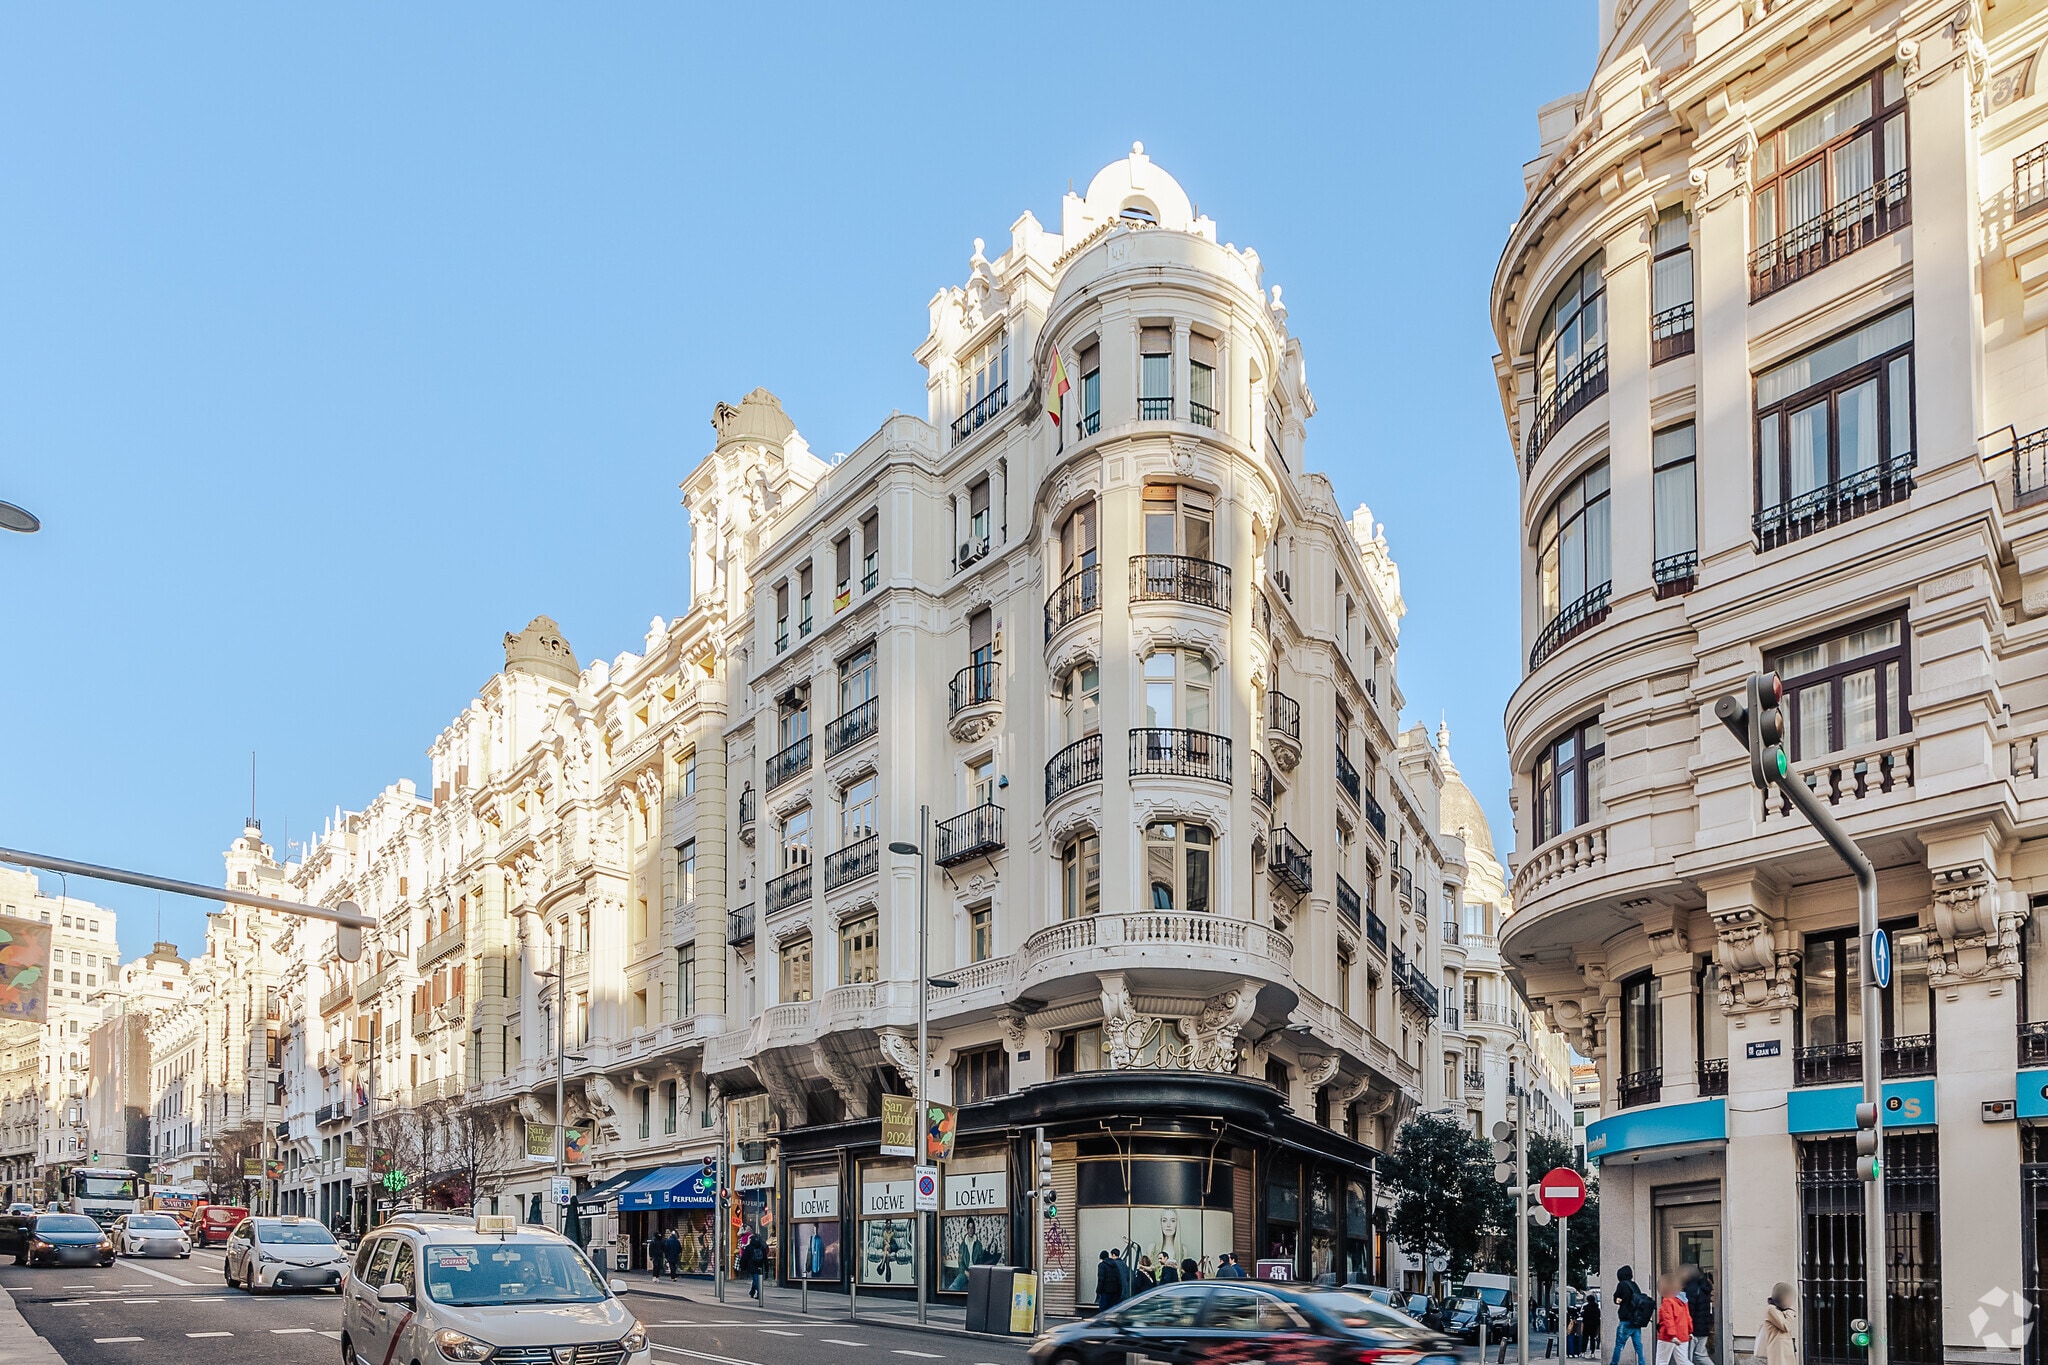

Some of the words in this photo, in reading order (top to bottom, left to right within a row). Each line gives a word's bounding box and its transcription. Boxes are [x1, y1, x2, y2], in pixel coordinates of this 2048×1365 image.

[1117, 1018, 1238, 1072] Loewe
[1755, 1048, 1769, 1056] GRAN
[1770, 1046, 1779, 1055] VÍA
[884, 1099, 902, 1112] San
[1890, 1099, 1899, 1108] B
[1904, 1098, 1921, 1118] S
[884, 1112, 913, 1126] Antón
[529, 1126, 544, 1134] San
[529, 1133, 553, 1142] Antón
[887, 1131, 912, 1145] 2024
[672, 1195, 714, 1203] PERFUMERÍA
[871, 1195, 905, 1211] LOEWE
[956, 1189, 995, 1206] LOEWE
[801, 1200, 830, 1215] LOEWE
